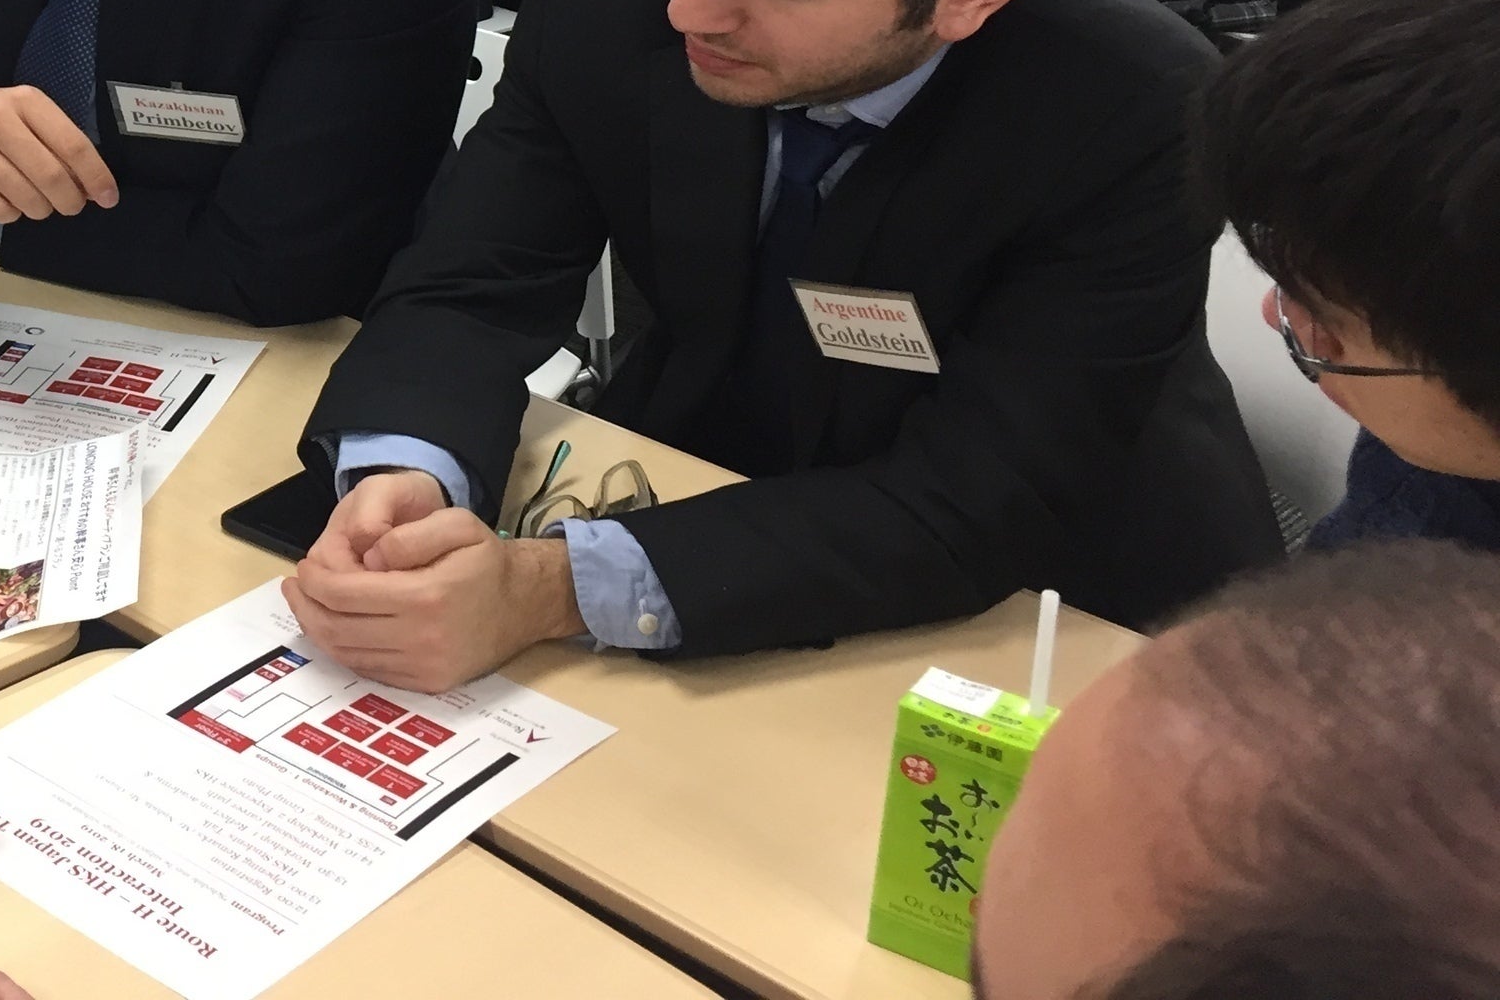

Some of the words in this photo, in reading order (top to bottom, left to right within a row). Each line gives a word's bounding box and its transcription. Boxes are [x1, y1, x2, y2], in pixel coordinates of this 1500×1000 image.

[130, 110, 237, 133] Primbetov
[134, 97, 225, 117] Kazakhstan
[812, 296, 908, 323] Argentine
[816, 322, 928, 355] Goldstein
[83, 441, 97, 473] LONGING
[80, 475, 94, 500] HOUSE
[947, 732, 1004, 762] 伊藤園
[252, 750, 290, 775] Groups
[298, 774, 350, 807] Workshop
[26, 815, 78, 849] 2019
[77, 822, 110, 843] 2019
[356, 804, 401, 832] Opening
[7, 825, 75, 868] Japan
[920, 793, 978, 895] お茶
[64, 862, 118, 897] HKS
[123, 850, 166, 879] March
[269, 857, 300, 877] HKS
[70, 844, 185, 917] Interaction
[129, 902, 155, 920] H
[227, 897, 288, 936] Program
[149, 914, 220, 959] Route
